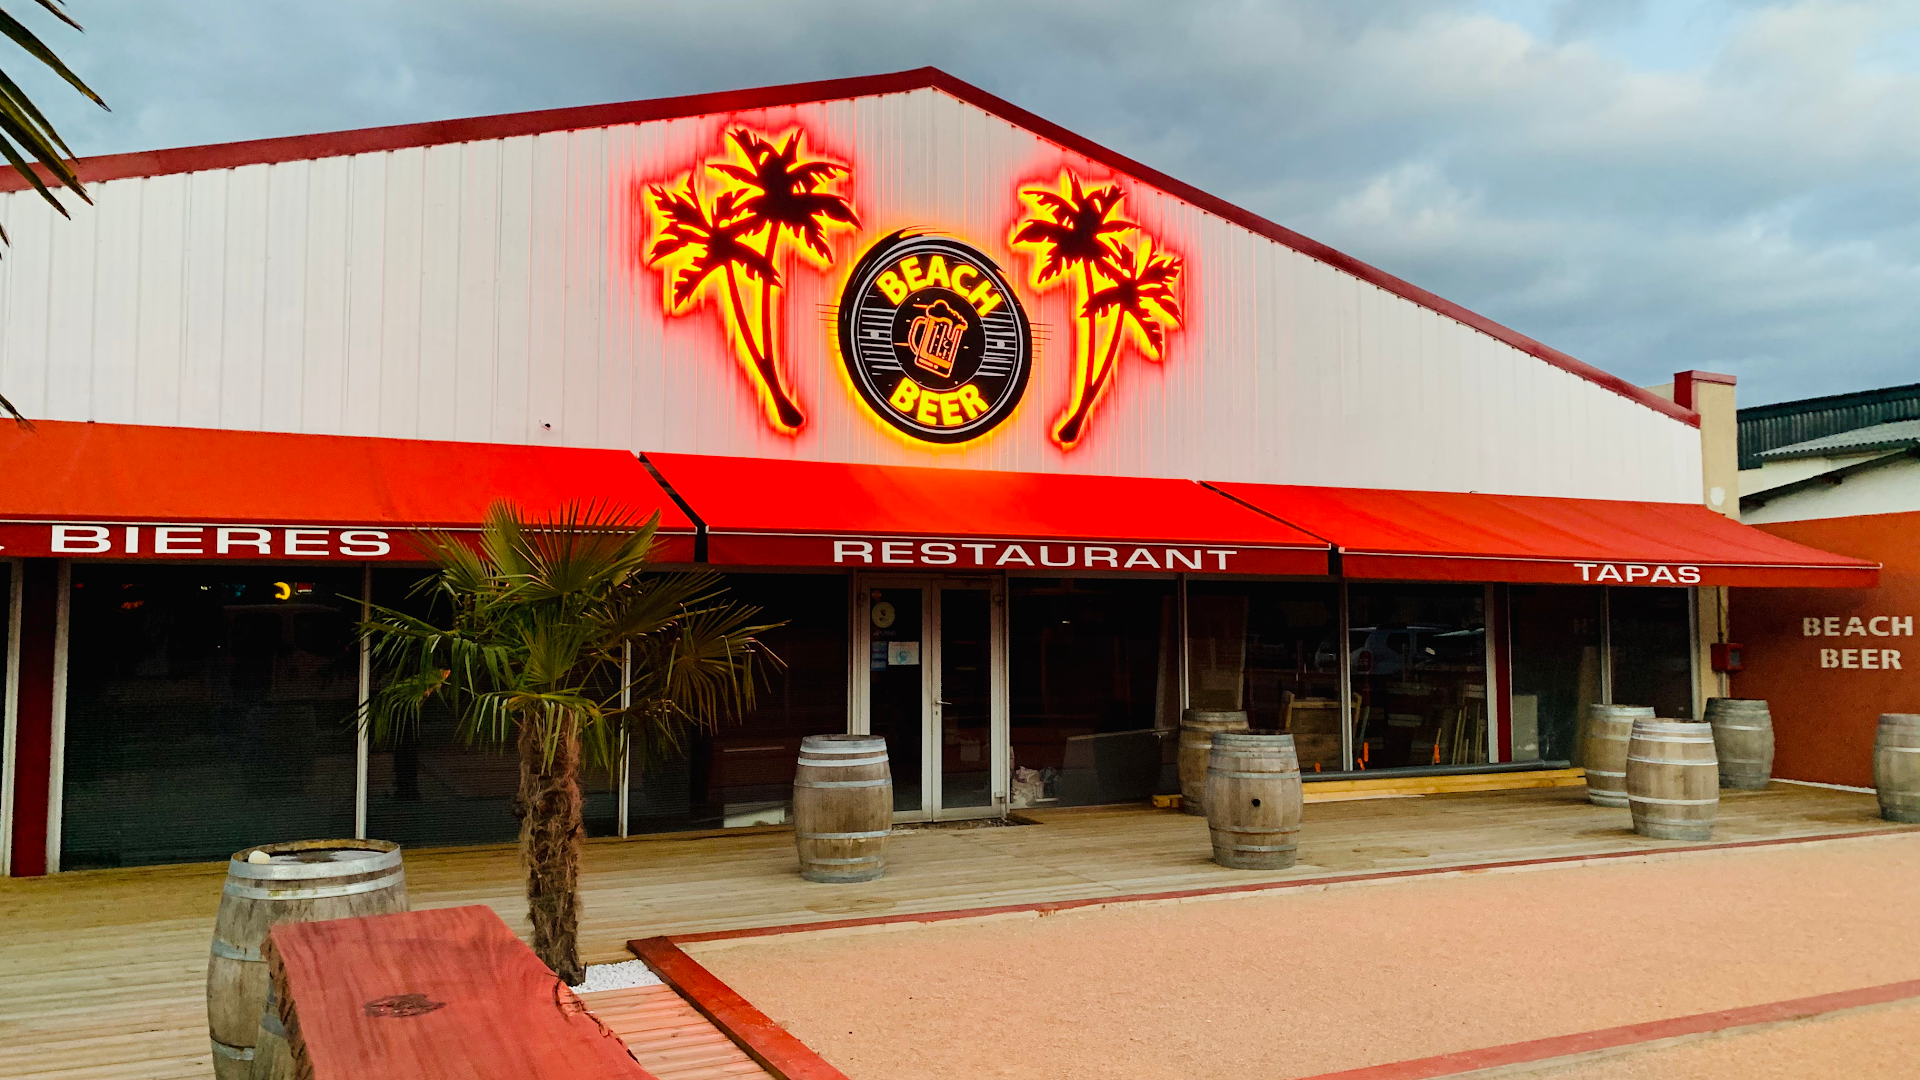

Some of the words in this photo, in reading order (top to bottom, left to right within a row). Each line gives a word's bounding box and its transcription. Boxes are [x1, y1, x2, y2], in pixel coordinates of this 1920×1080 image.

[876, 255, 1003, 317] BEACH
[889, 377, 990, 426] BEER
[50, 524, 391, 557] BIERES
[832, 540, 1238, 570] RESTAURANT
[1573, 563, 1701, 584] TAPAS
[1803, 616, 1914, 637] BEACH
[1820, 648, 1903, 670] BEER
